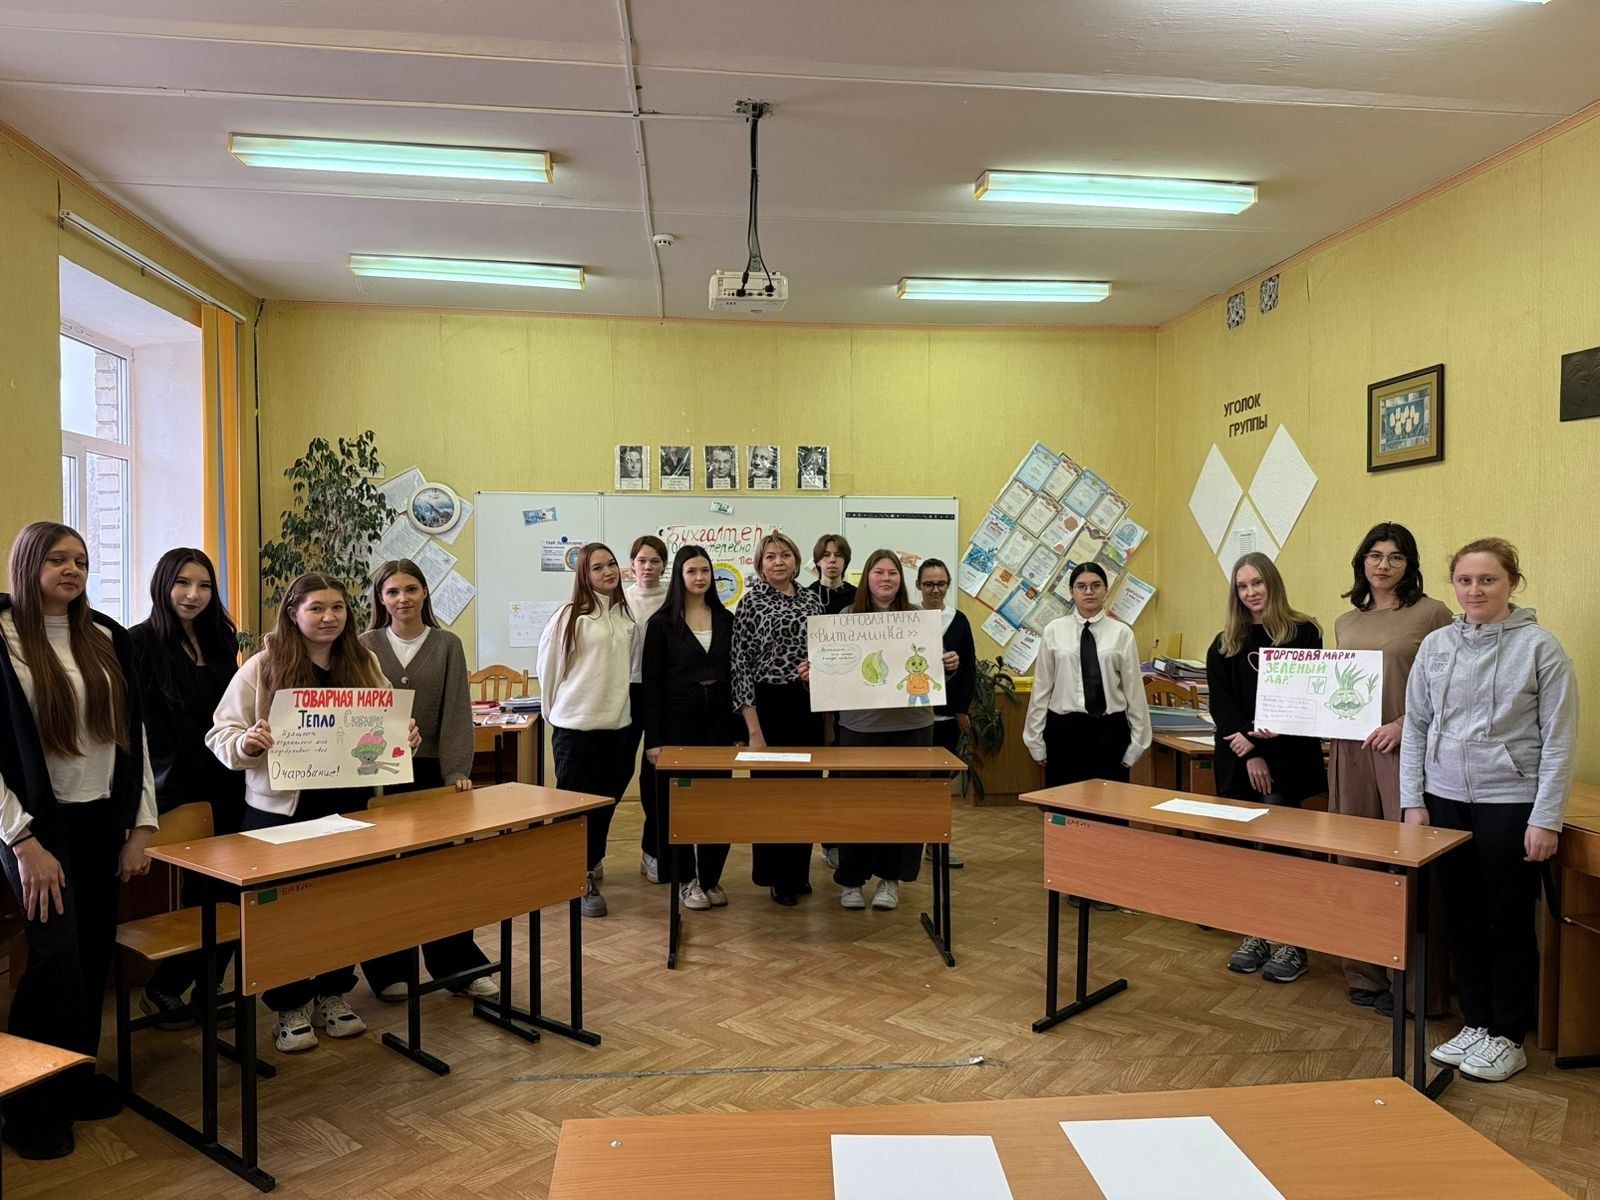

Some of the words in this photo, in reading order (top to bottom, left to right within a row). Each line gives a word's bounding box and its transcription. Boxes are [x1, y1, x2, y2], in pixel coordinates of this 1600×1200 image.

[1223, 392, 1261, 418] УГОЛОК
[1229, 414, 1268, 438] ГРУППЫ
[830, 614, 883, 627] ТОРГОВАЯ
[887, 611, 920, 624] МАРКА
[1263, 650, 1321, 661] ТОРГОВАЯ
[1323, 651, 1355, 660] МАРКА
[292, 690, 354, 708] ТОВАРНАЯ
[357, 690, 394, 708] МАРКА
[272, 761, 340, 780] Очарование!
